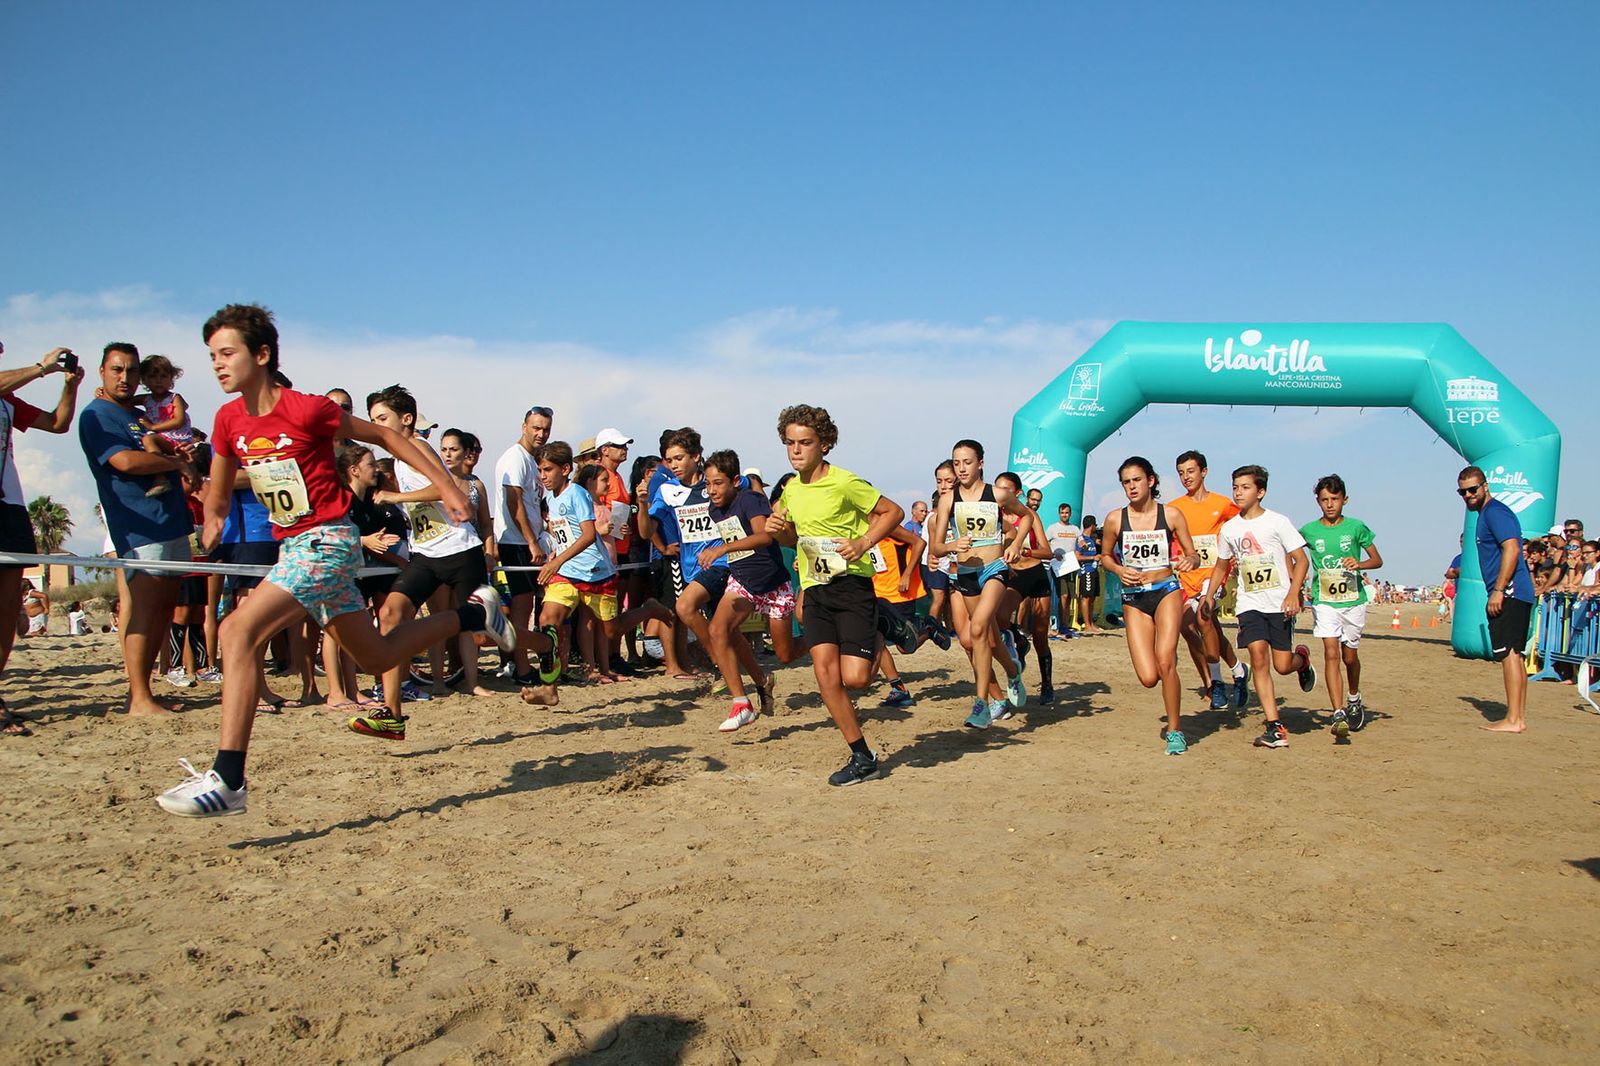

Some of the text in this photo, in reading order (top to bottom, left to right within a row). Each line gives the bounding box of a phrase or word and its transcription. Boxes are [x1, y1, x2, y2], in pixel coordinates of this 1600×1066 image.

[1204, 336, 1327, 376] Islantilla
[1264, 380, 1343, 390] MANCOMUNIDAD
[415, 514, 433, 533] 62
[686, 516, 712, 533] 242
[966, 517, 987, 531] 59
[1131, 544, 1160, 559] 264
[815, 556, 831, 574] 61
[1246, 568, 1272, 584] 167
[1329, 582, 1347, 595] 60
